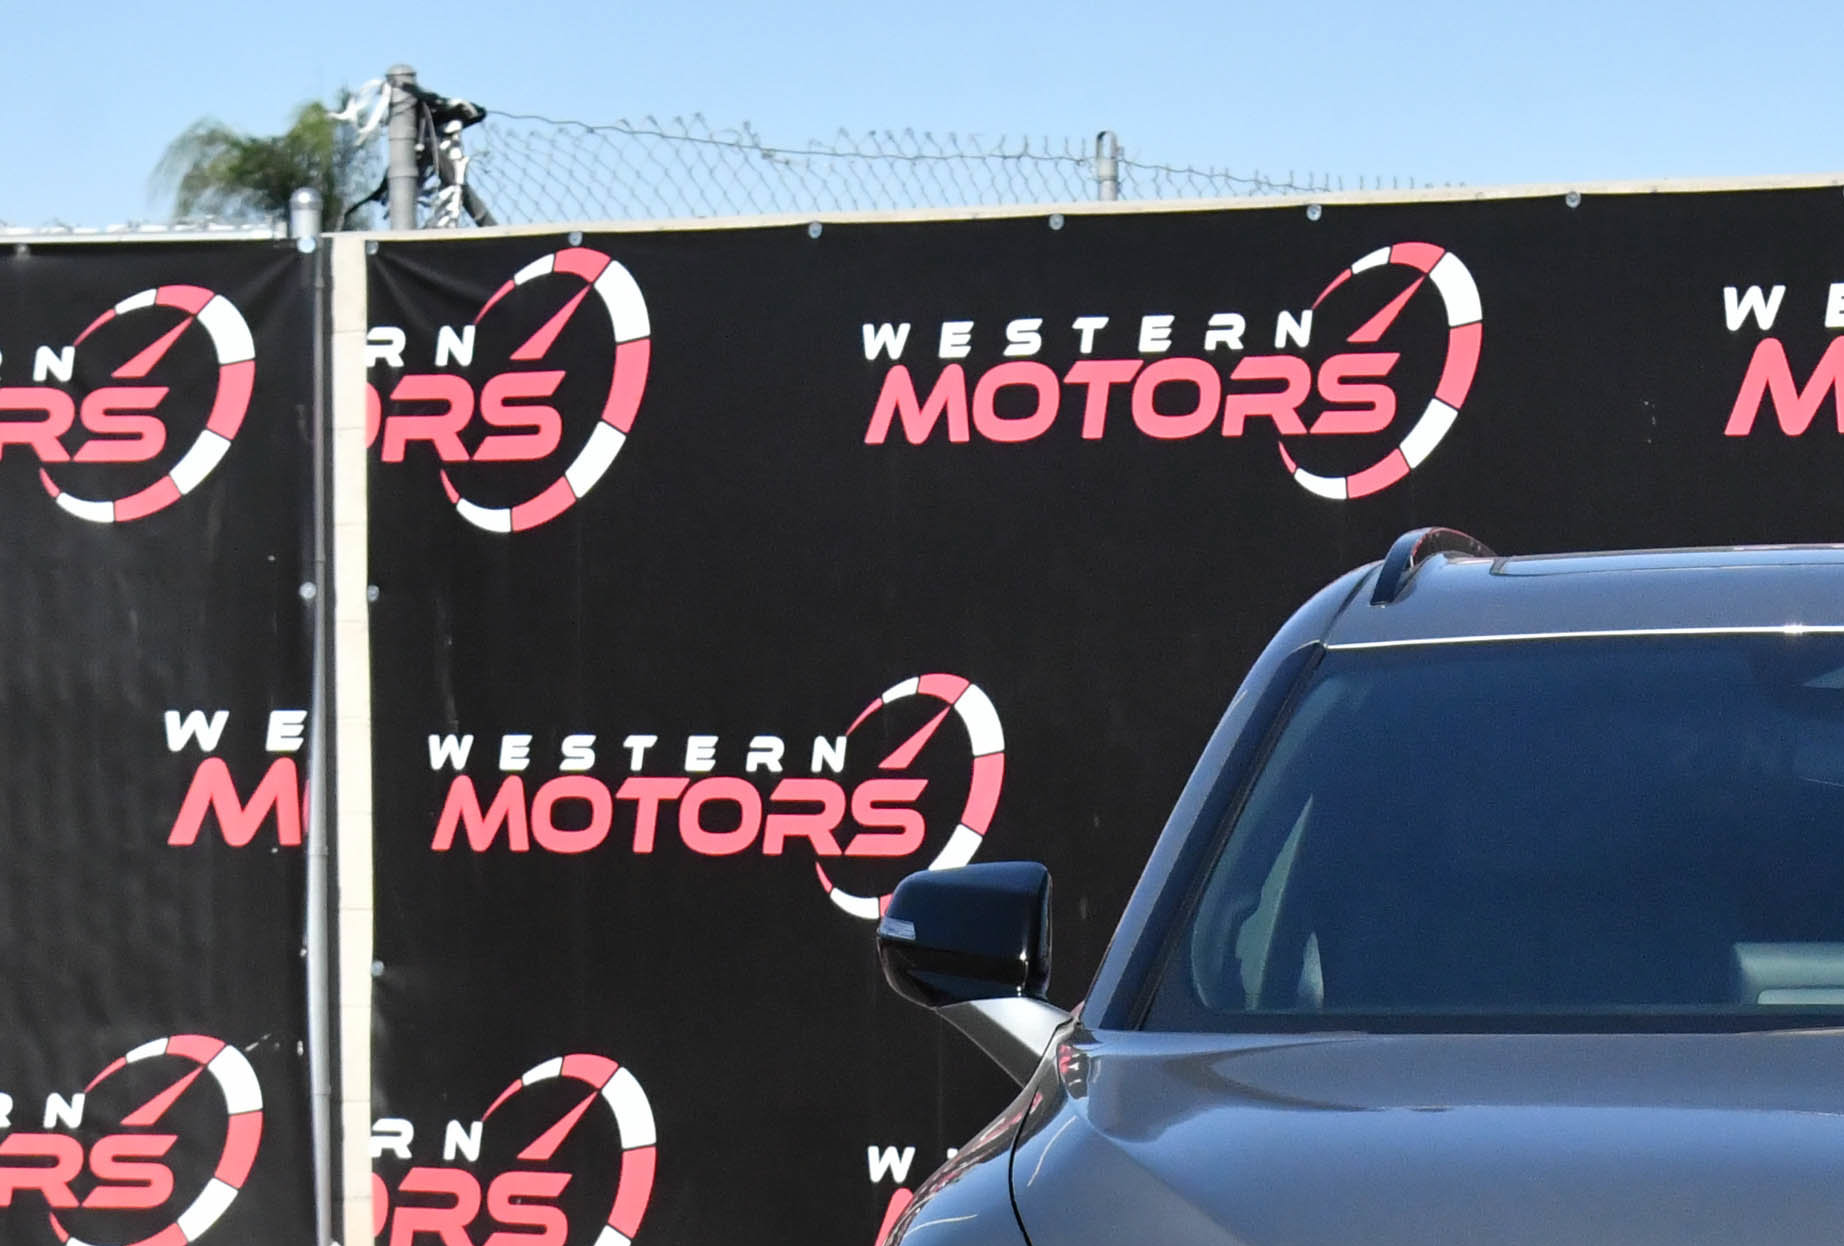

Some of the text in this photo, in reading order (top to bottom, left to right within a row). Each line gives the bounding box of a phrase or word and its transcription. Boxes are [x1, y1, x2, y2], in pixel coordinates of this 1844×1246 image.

[862, 309, 1313, 361] WESTERN
[365, 369, 566, 463] RS
[864, 351, 1401, 446] MOTORS
[164, 709, 308, 752] WE
[428, 734, 847, 774] WESTERN
[167, 756, 310, 848] M
[431, 774, 929, 858] MOTORS
